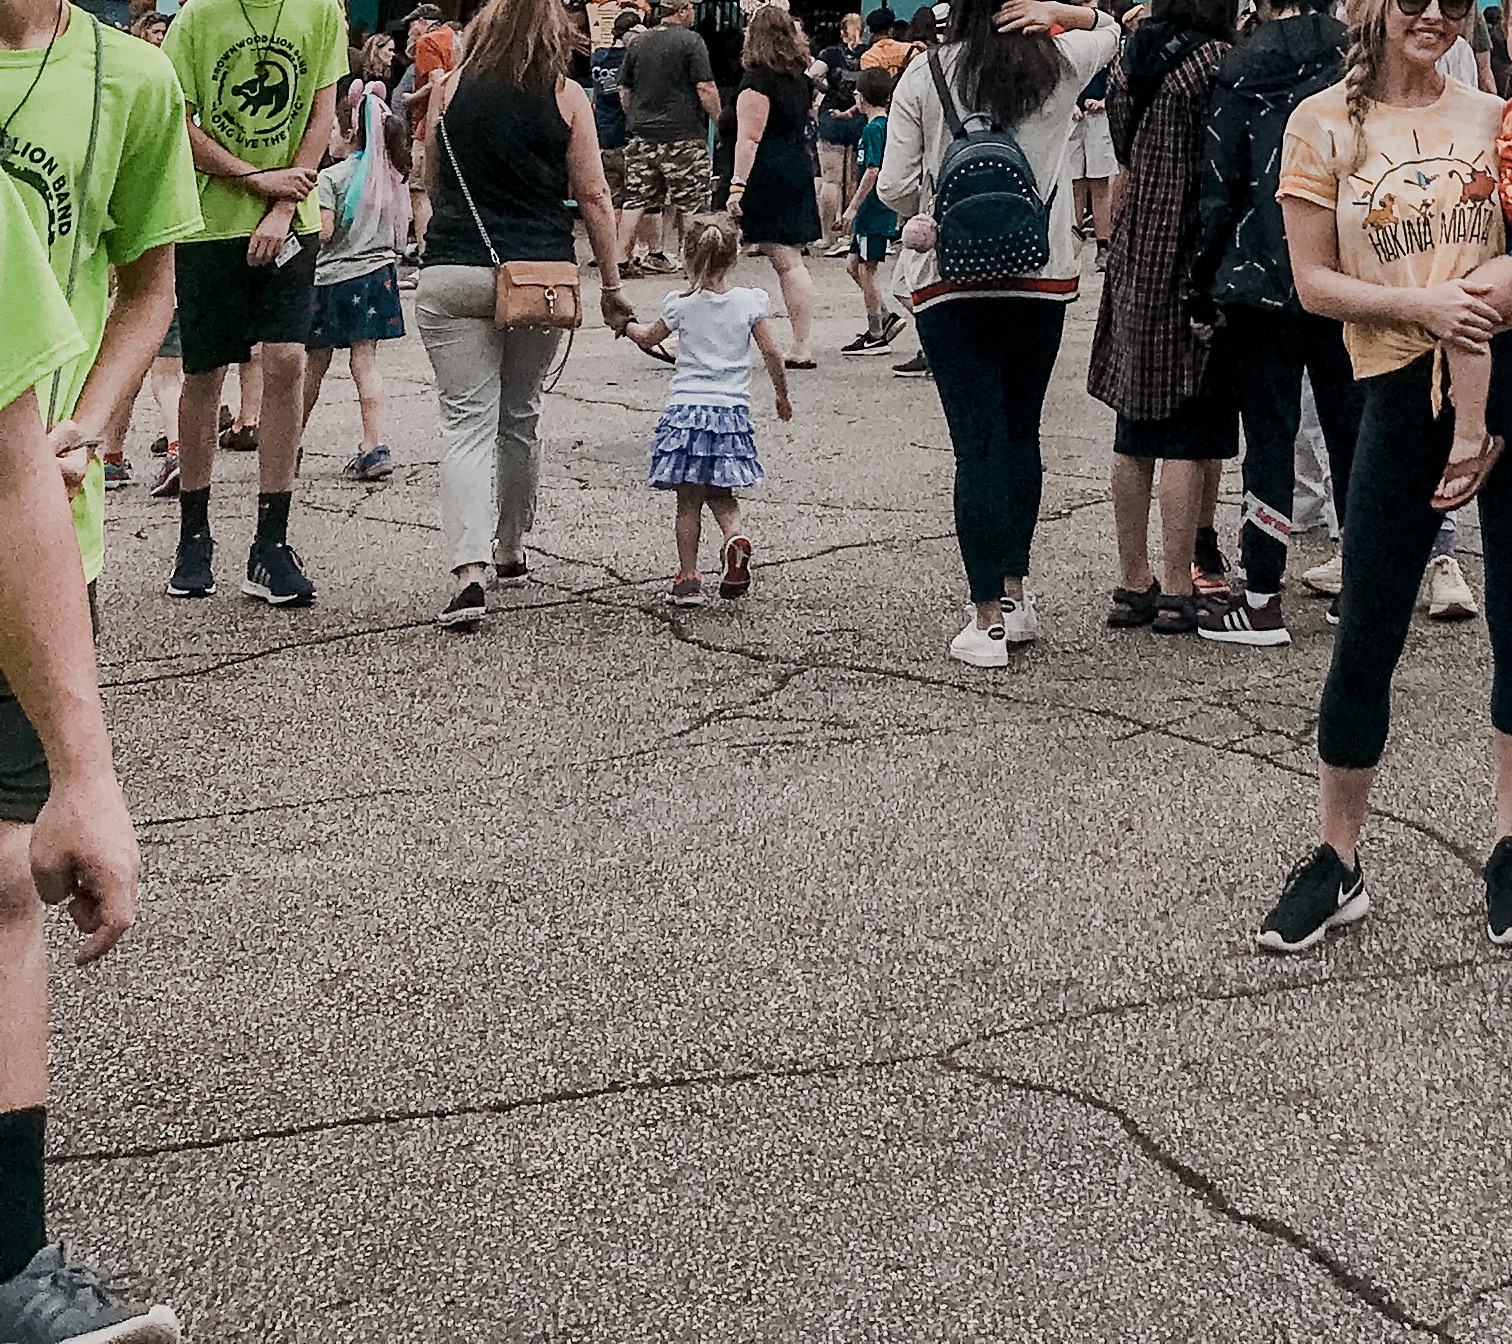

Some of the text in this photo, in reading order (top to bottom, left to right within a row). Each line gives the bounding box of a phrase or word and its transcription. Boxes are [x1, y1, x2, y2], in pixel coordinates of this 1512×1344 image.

[262, 130, 287, 148] THE
[10, 136, 73, 237] LION BAND
